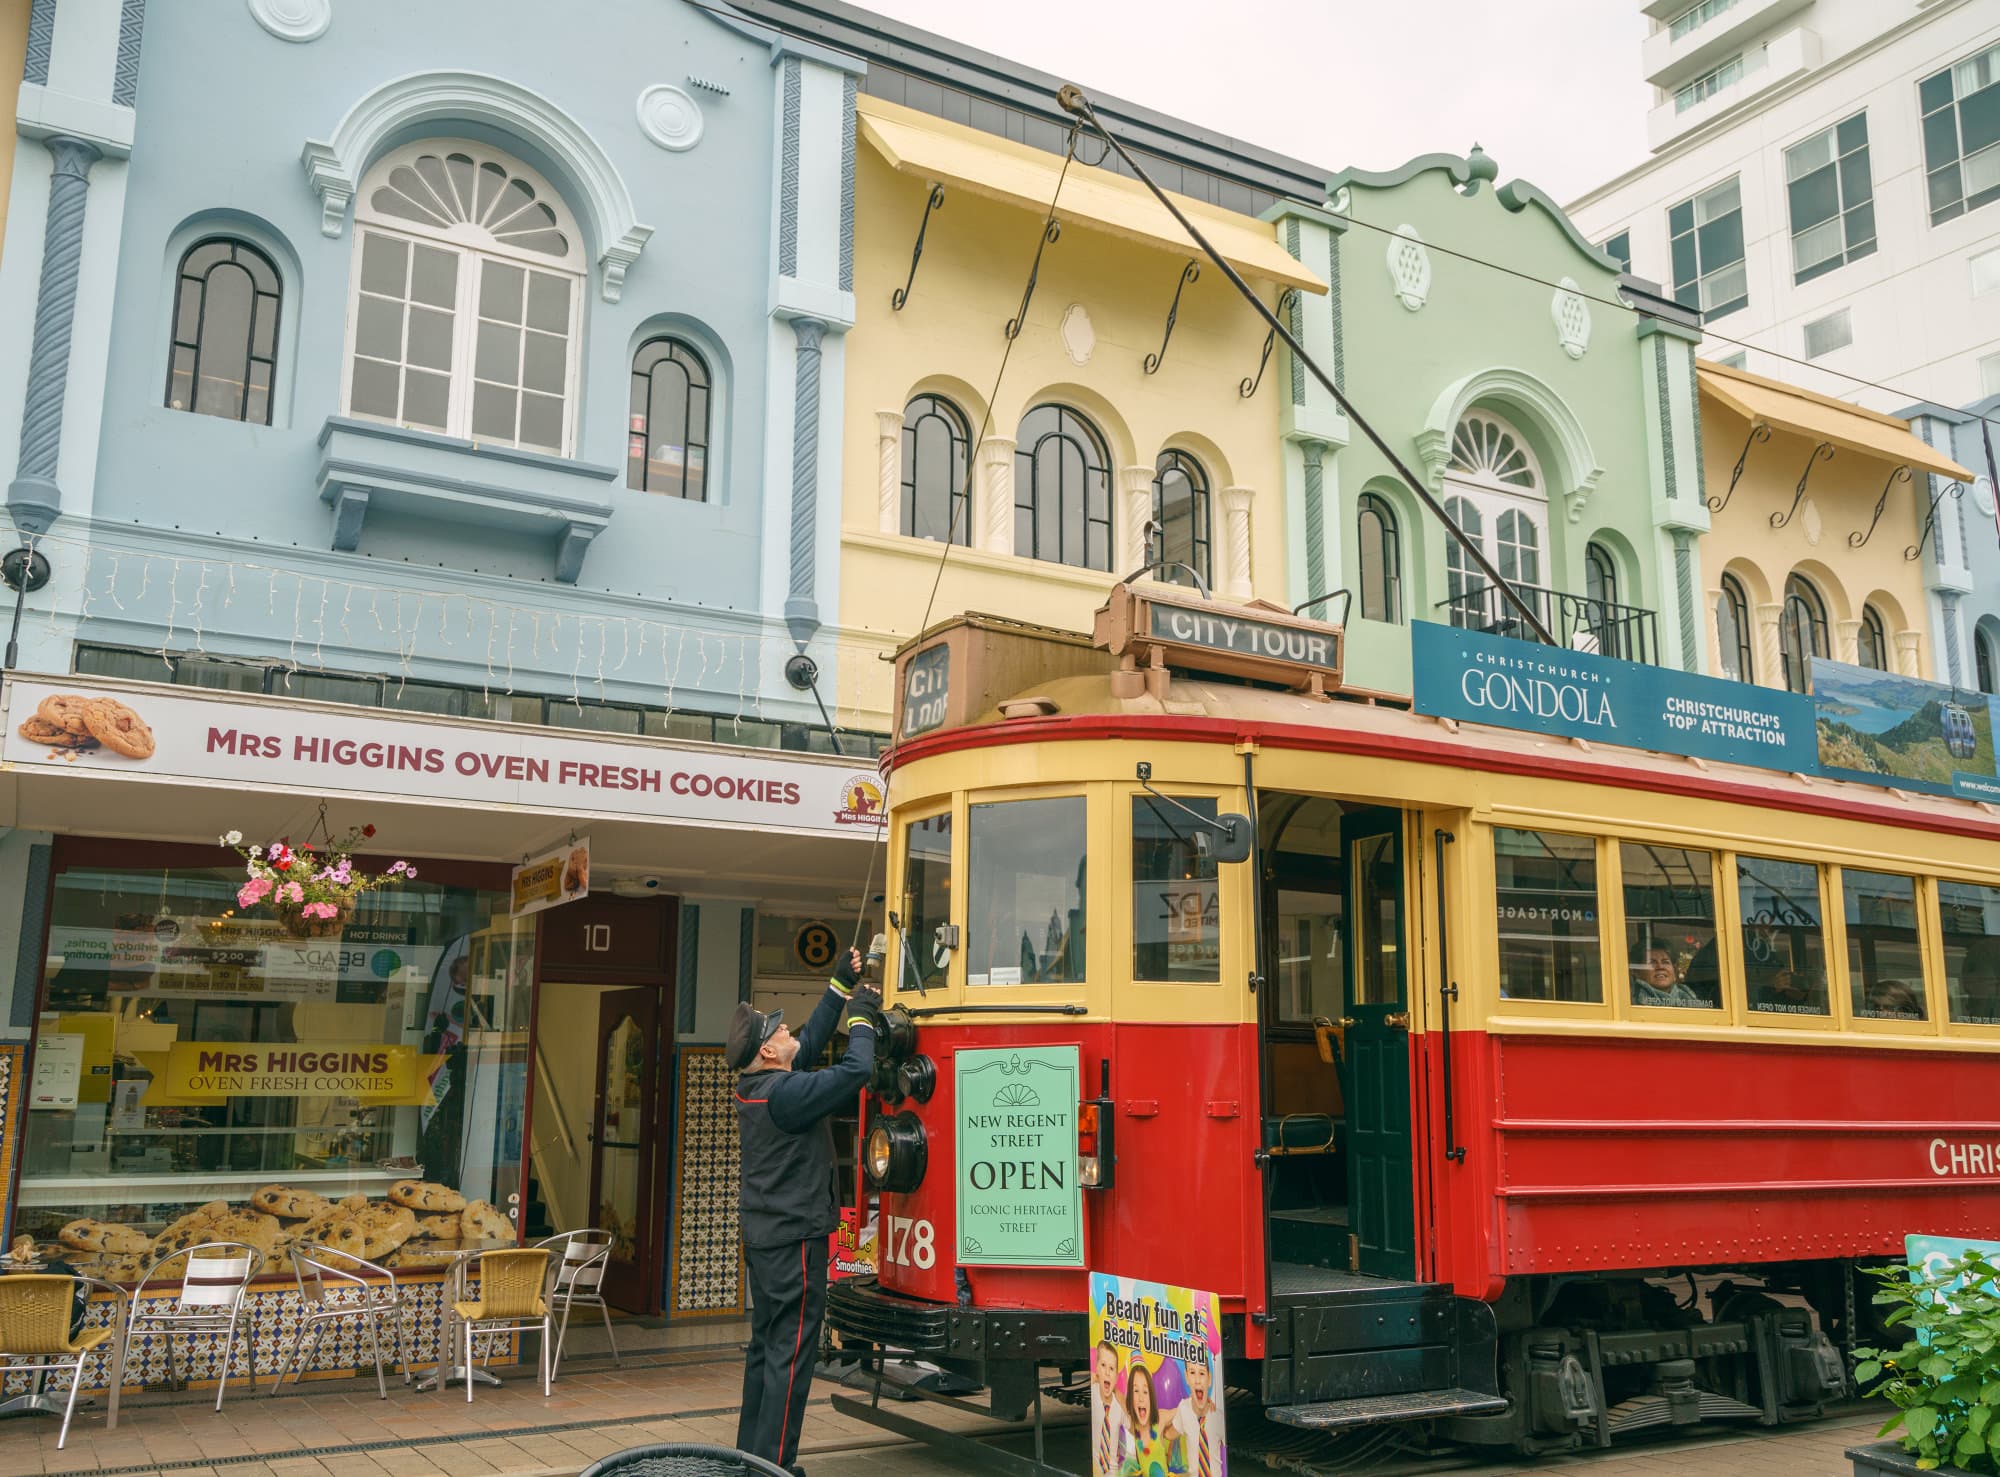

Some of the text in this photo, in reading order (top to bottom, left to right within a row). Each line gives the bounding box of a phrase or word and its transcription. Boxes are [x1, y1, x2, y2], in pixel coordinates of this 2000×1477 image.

[1171, 611, 1326, 664] CITY TOUR
[1476, 652, 1599, 683] CHRISTCHURCH
[1461, 668, 1617, 728] GONDOLA
[1701, 719, 1786, 746] ATTRACTION
[293, 736, 445, 773] HIGGINS
[455, 751, 549, 783] OVEN
[559, 761, 661, 792] FRESH
[669, 772, 801, 805] COOKIES
[349, 930, 408, 942] HOT DRINKS
[583, 924, 611, 952] 10
[805, 929, 830, 963] 8
[211, 951, 244, 963] $2.00
[267, 1052, 389, 1074] HIGGINS
[188, 1076, 394, 1090] OVEN FRESH COOKIES
[968, 1113, 1067, 1128] NEW REGENT
[990, 1134, 1044, 1148] STREET
[969, 1160, 1066, 1190] OPEN
[970, 1204, 1067, 1216] ICONIC HERITAGE
[999, 1222, 1037, 1233] STREET
[886, 1214, 936, 1270] 178
[835, 1256, 873, 1274] Smoothies
[1105, 1291, 1201, 1335] Beady fun at
[1103, 1320, 1206, 1365] Beadz Unlimited
